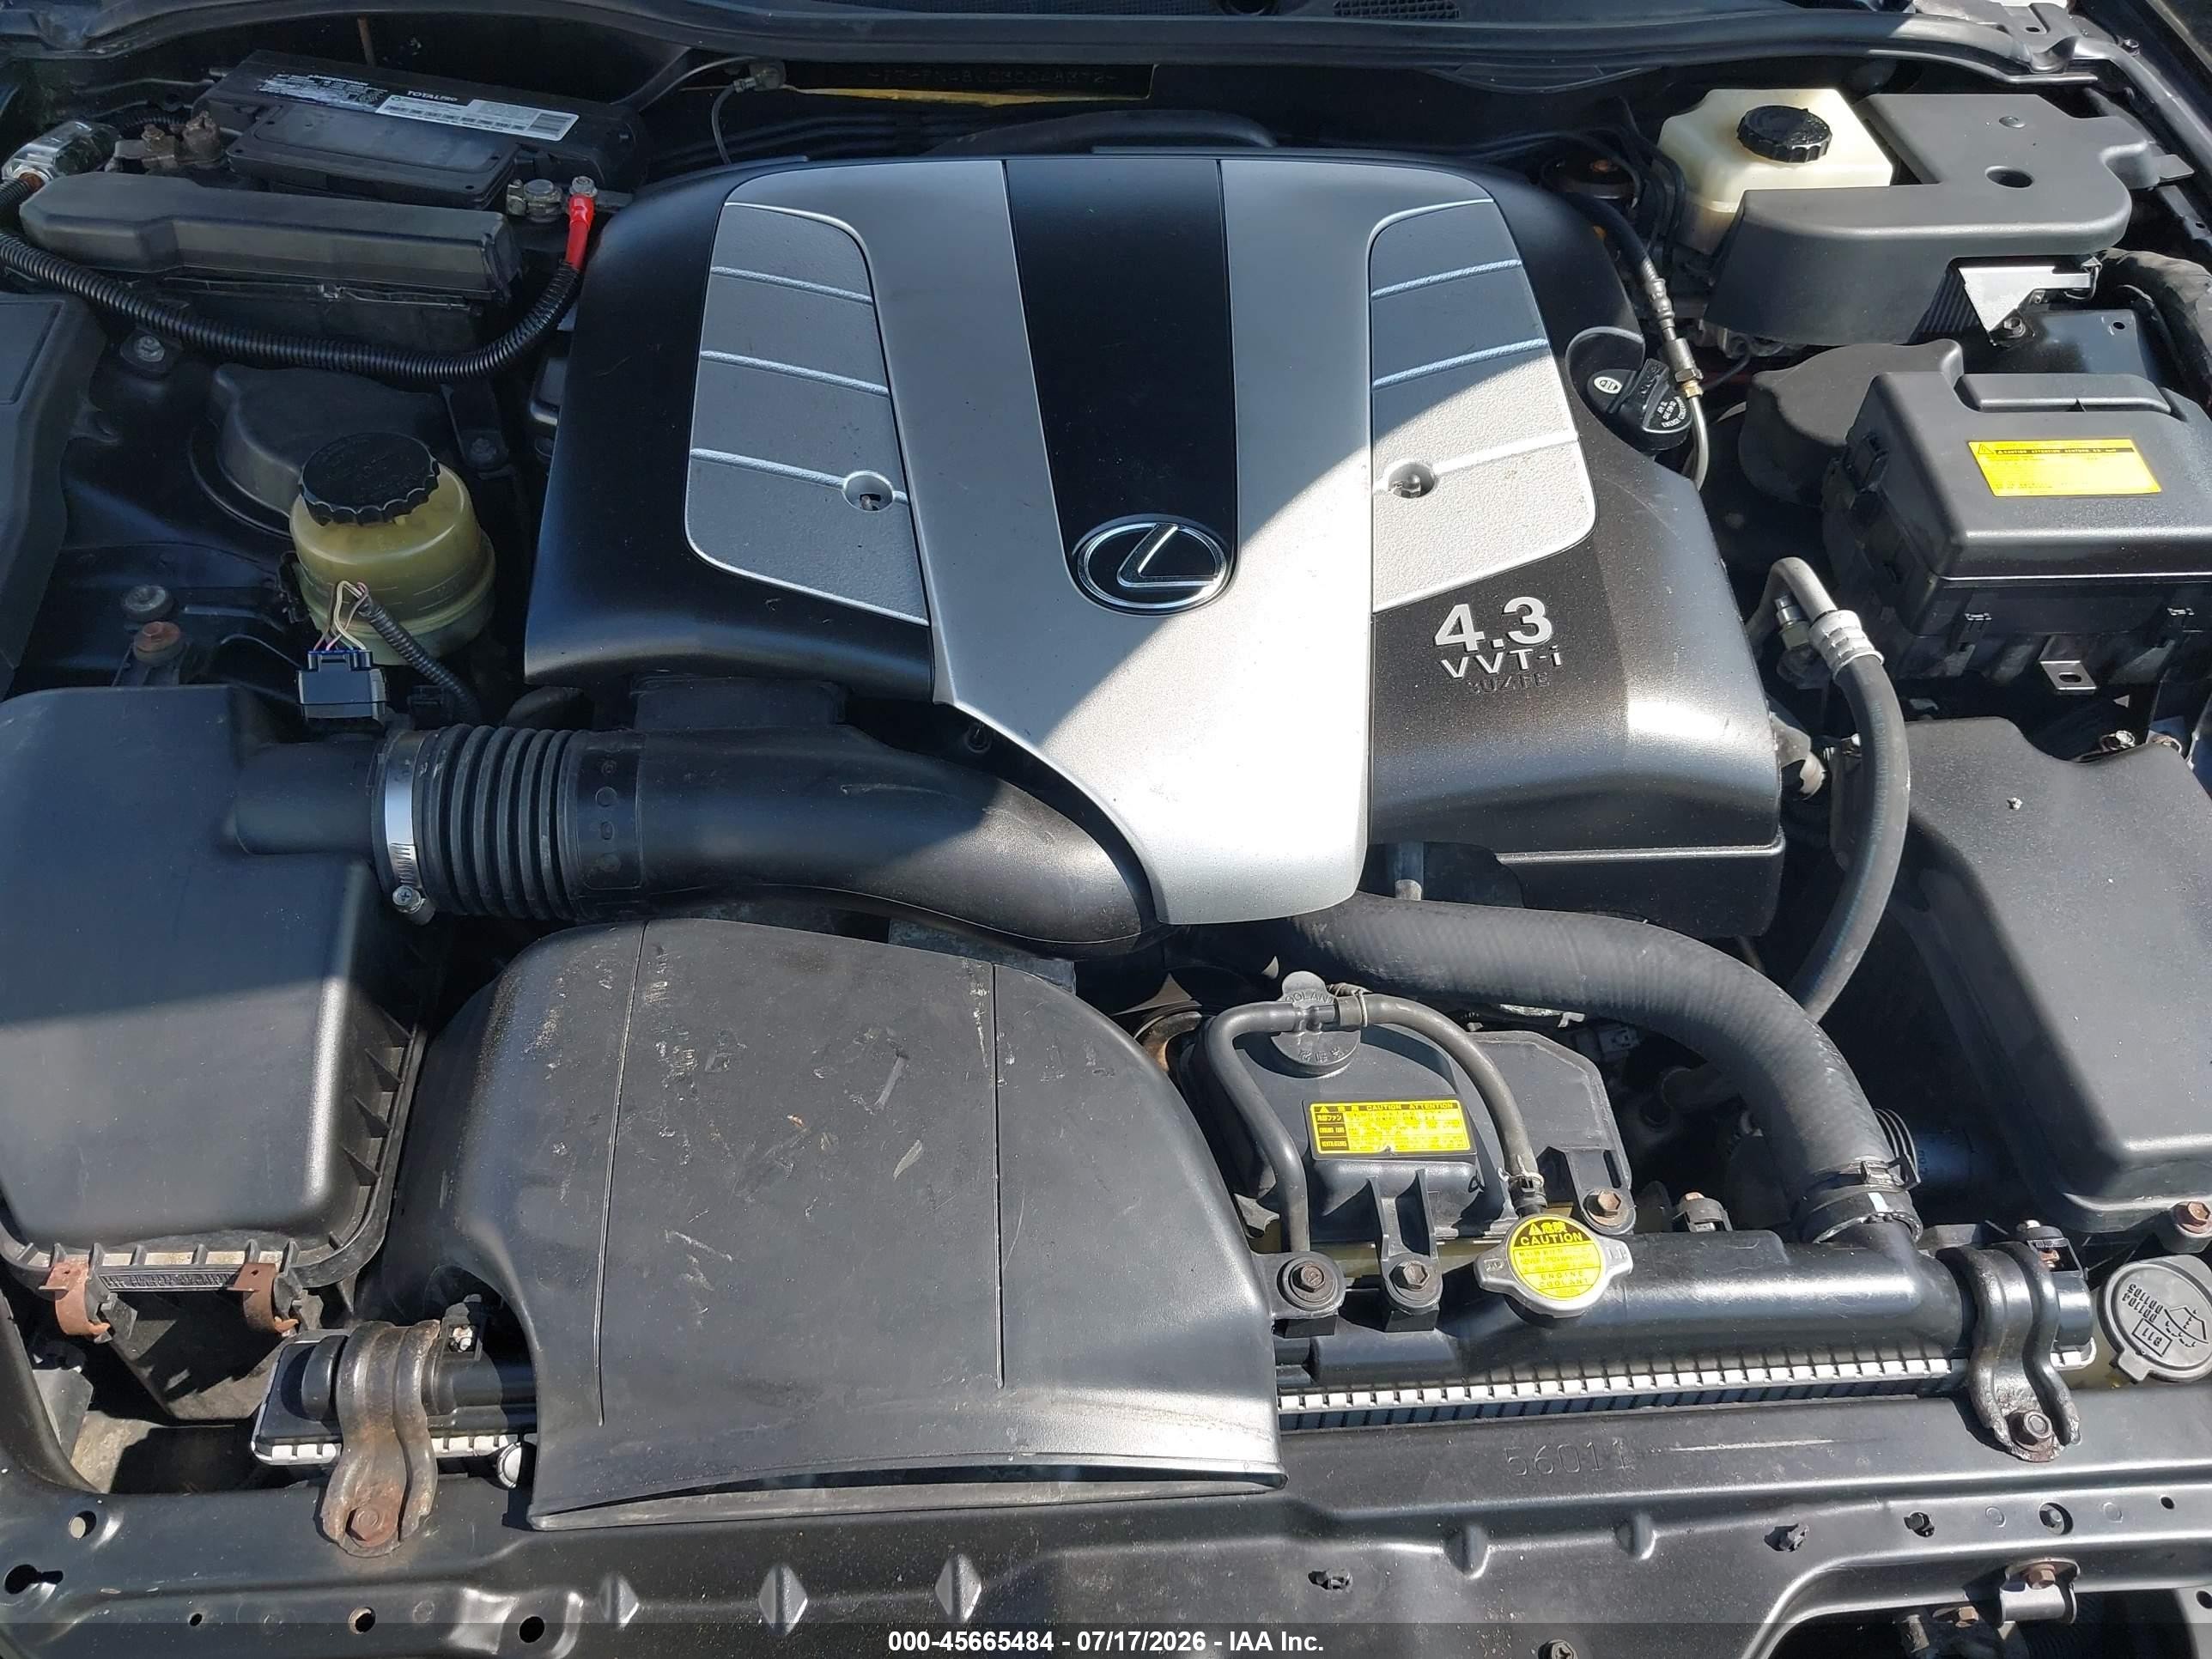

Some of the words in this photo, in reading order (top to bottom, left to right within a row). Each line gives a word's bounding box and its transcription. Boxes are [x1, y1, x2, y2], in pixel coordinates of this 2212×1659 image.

[1434, 596, 1553, 653] 4.3
[1440, 645, 1562, 678] VVT-i
[1408, 1103, 1455, 1111] ATTENTION
[1520, 1232, 1583, 1246] CAUTION
